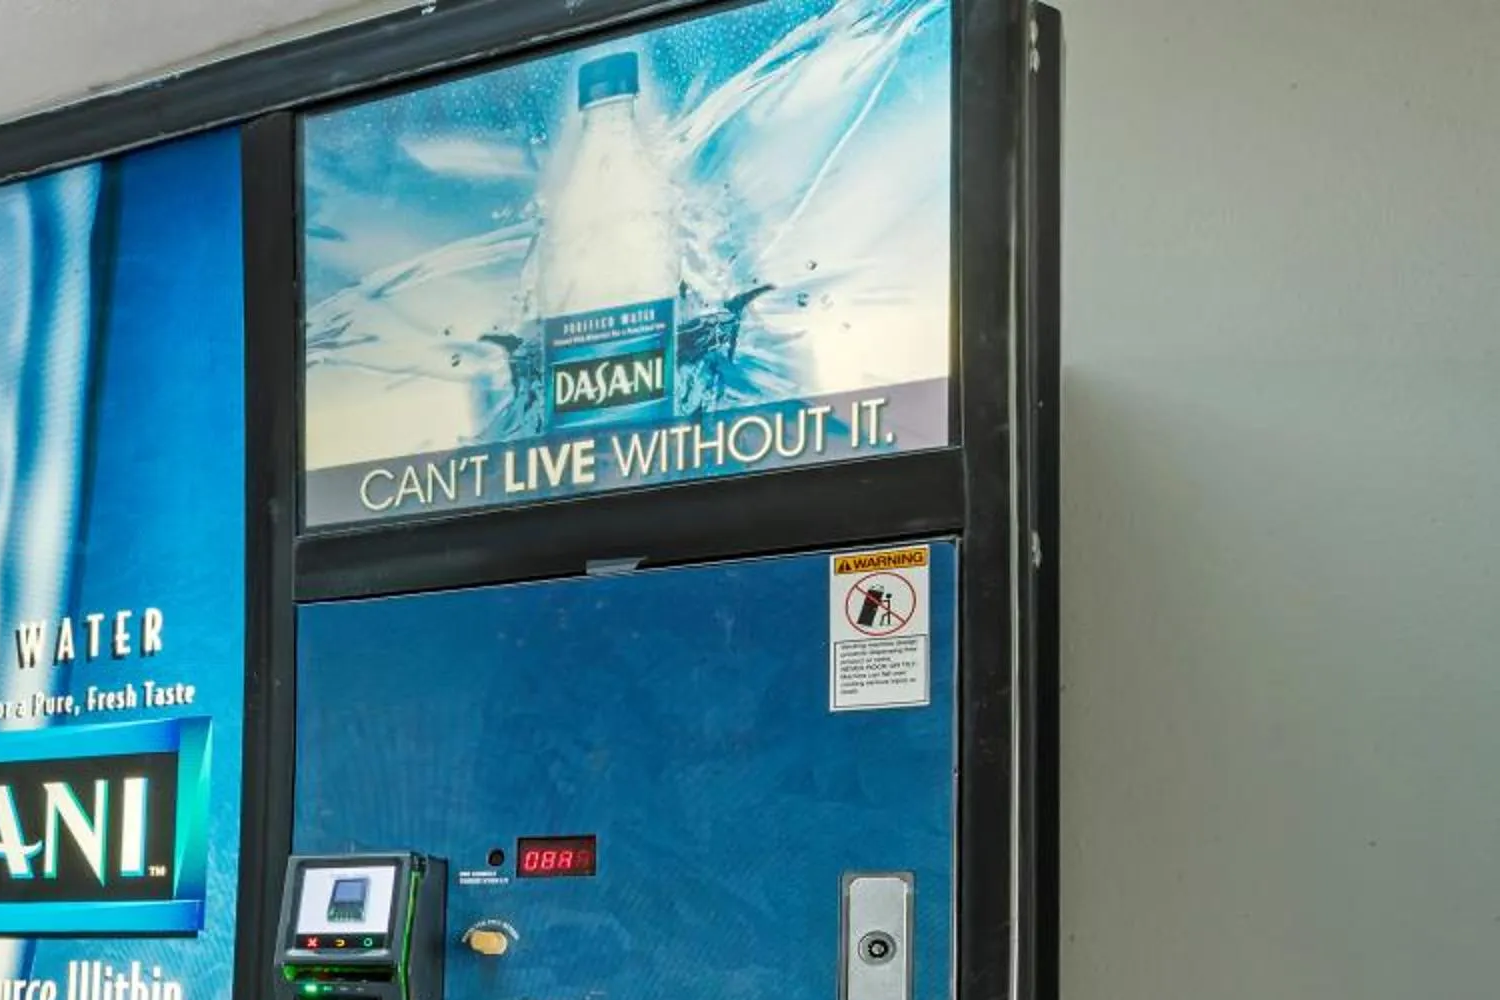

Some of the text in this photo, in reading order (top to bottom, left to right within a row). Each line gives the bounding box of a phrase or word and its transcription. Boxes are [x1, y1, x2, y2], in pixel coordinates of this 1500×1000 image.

[555, 357, 663, 405] DASANI
[360, 397, 895, 512] CAN'T LIVE WITHOUT IT.
[853, 551, 923, 570] WARNING
[16, 607, 164, 669] WATER
[31, 691, 81, 718] Pure,
[87, 684, 138, 711] Fresh
[143, 680, 197, 708] Taste
